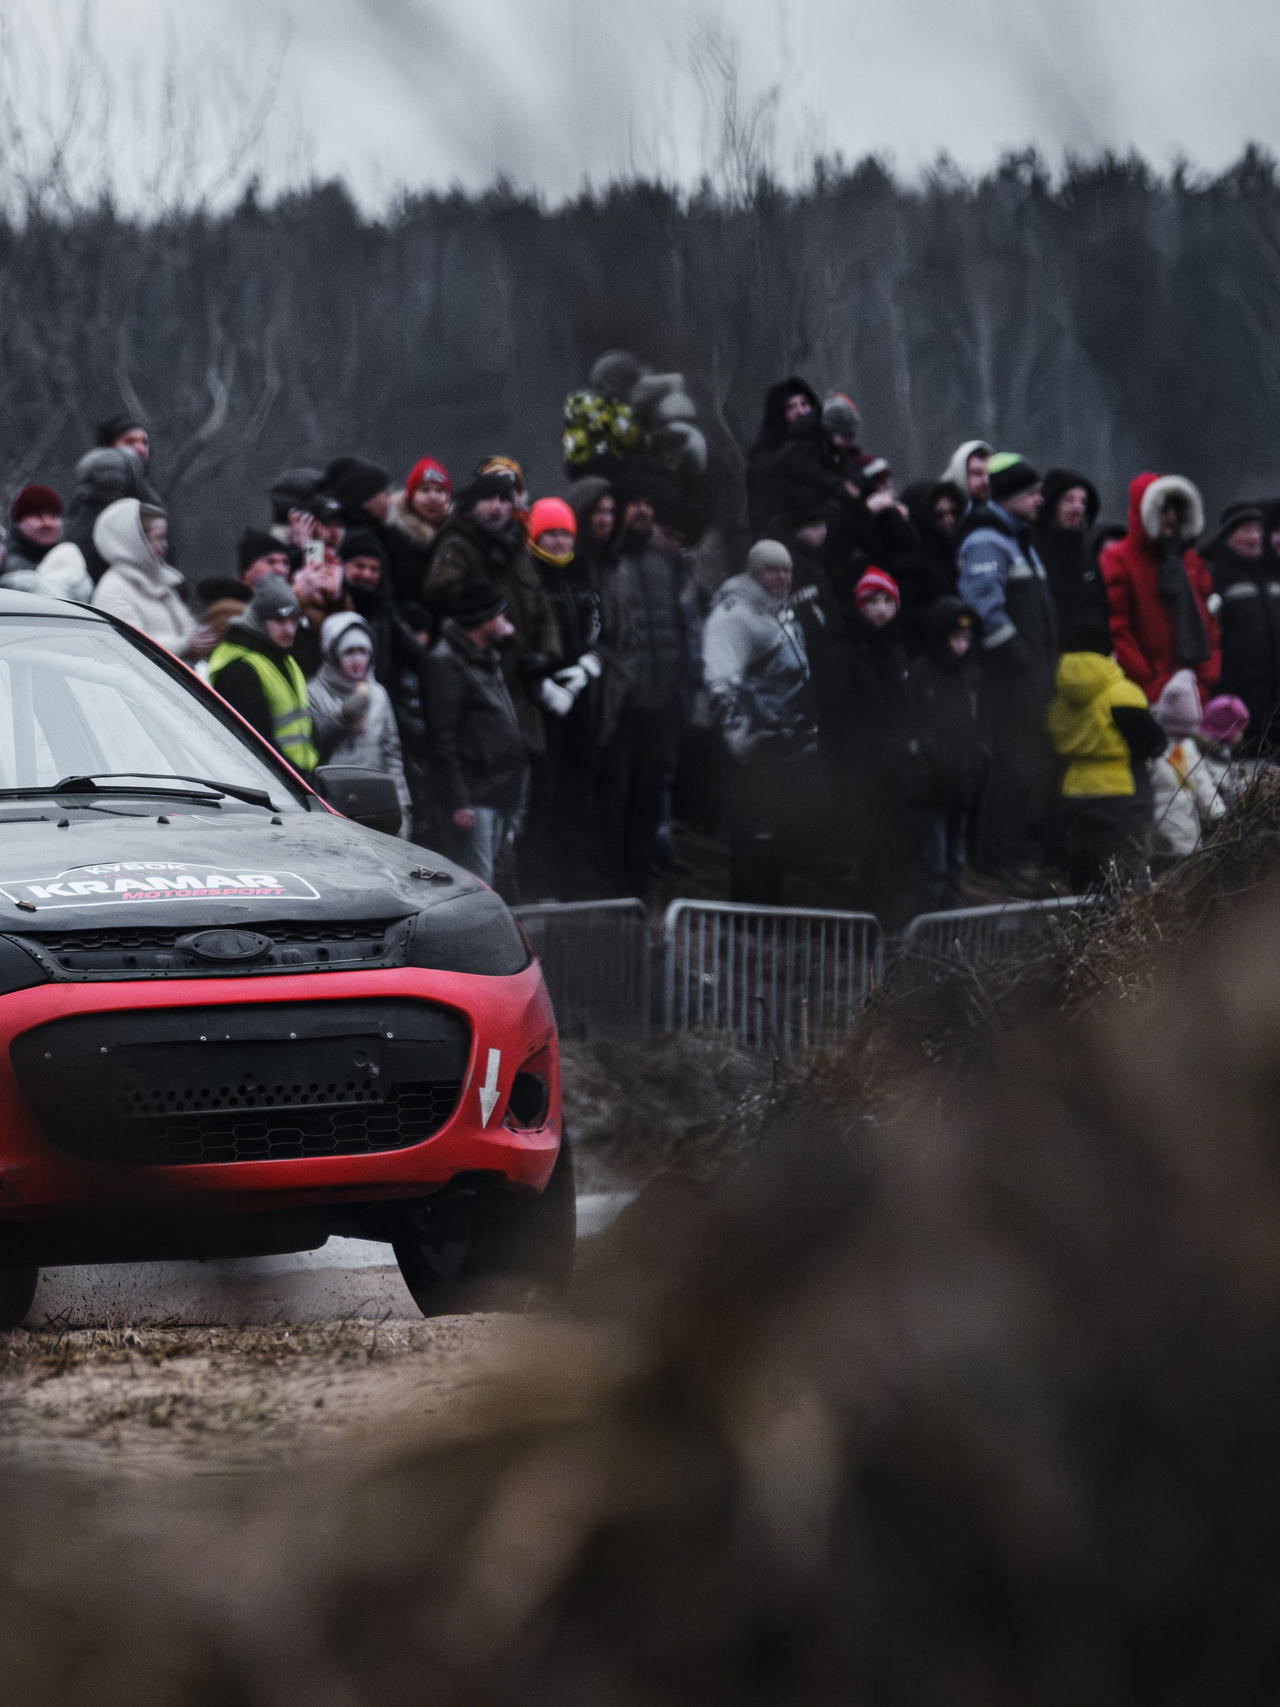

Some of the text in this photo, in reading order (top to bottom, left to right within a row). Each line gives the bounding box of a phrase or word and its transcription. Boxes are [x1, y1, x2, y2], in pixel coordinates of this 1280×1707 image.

[83, 863, 189, 875] КУБОК
[26, 874, 287, 899] KRAMAR
[121, 888, 288, 900] MOTORSPORT
